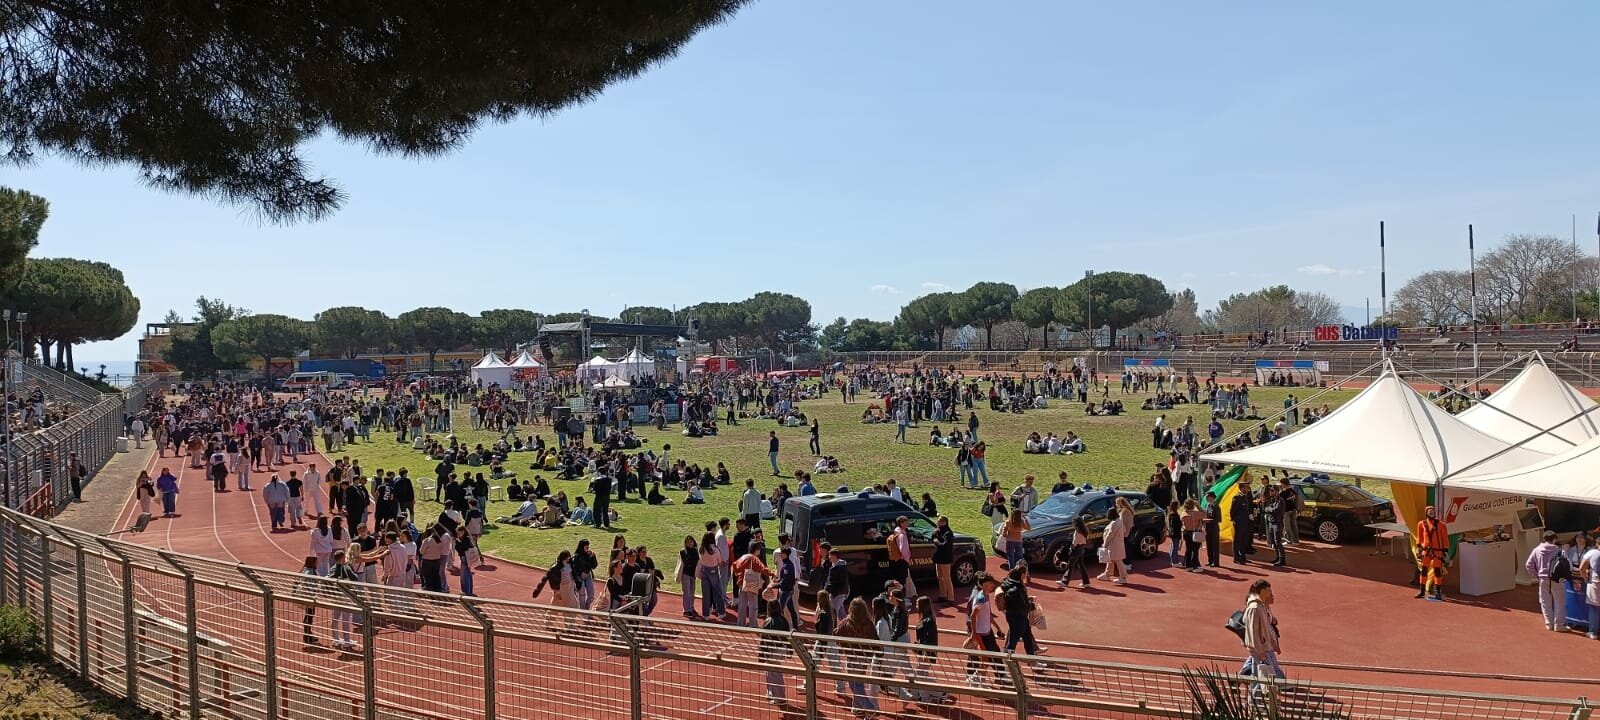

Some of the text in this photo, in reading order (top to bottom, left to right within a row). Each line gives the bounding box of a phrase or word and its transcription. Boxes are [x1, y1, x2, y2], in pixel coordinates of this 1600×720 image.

[1315, 325, 1339, 340] CUS
[1463, 496, 1523, 511] GUARDIA COSTIERA
